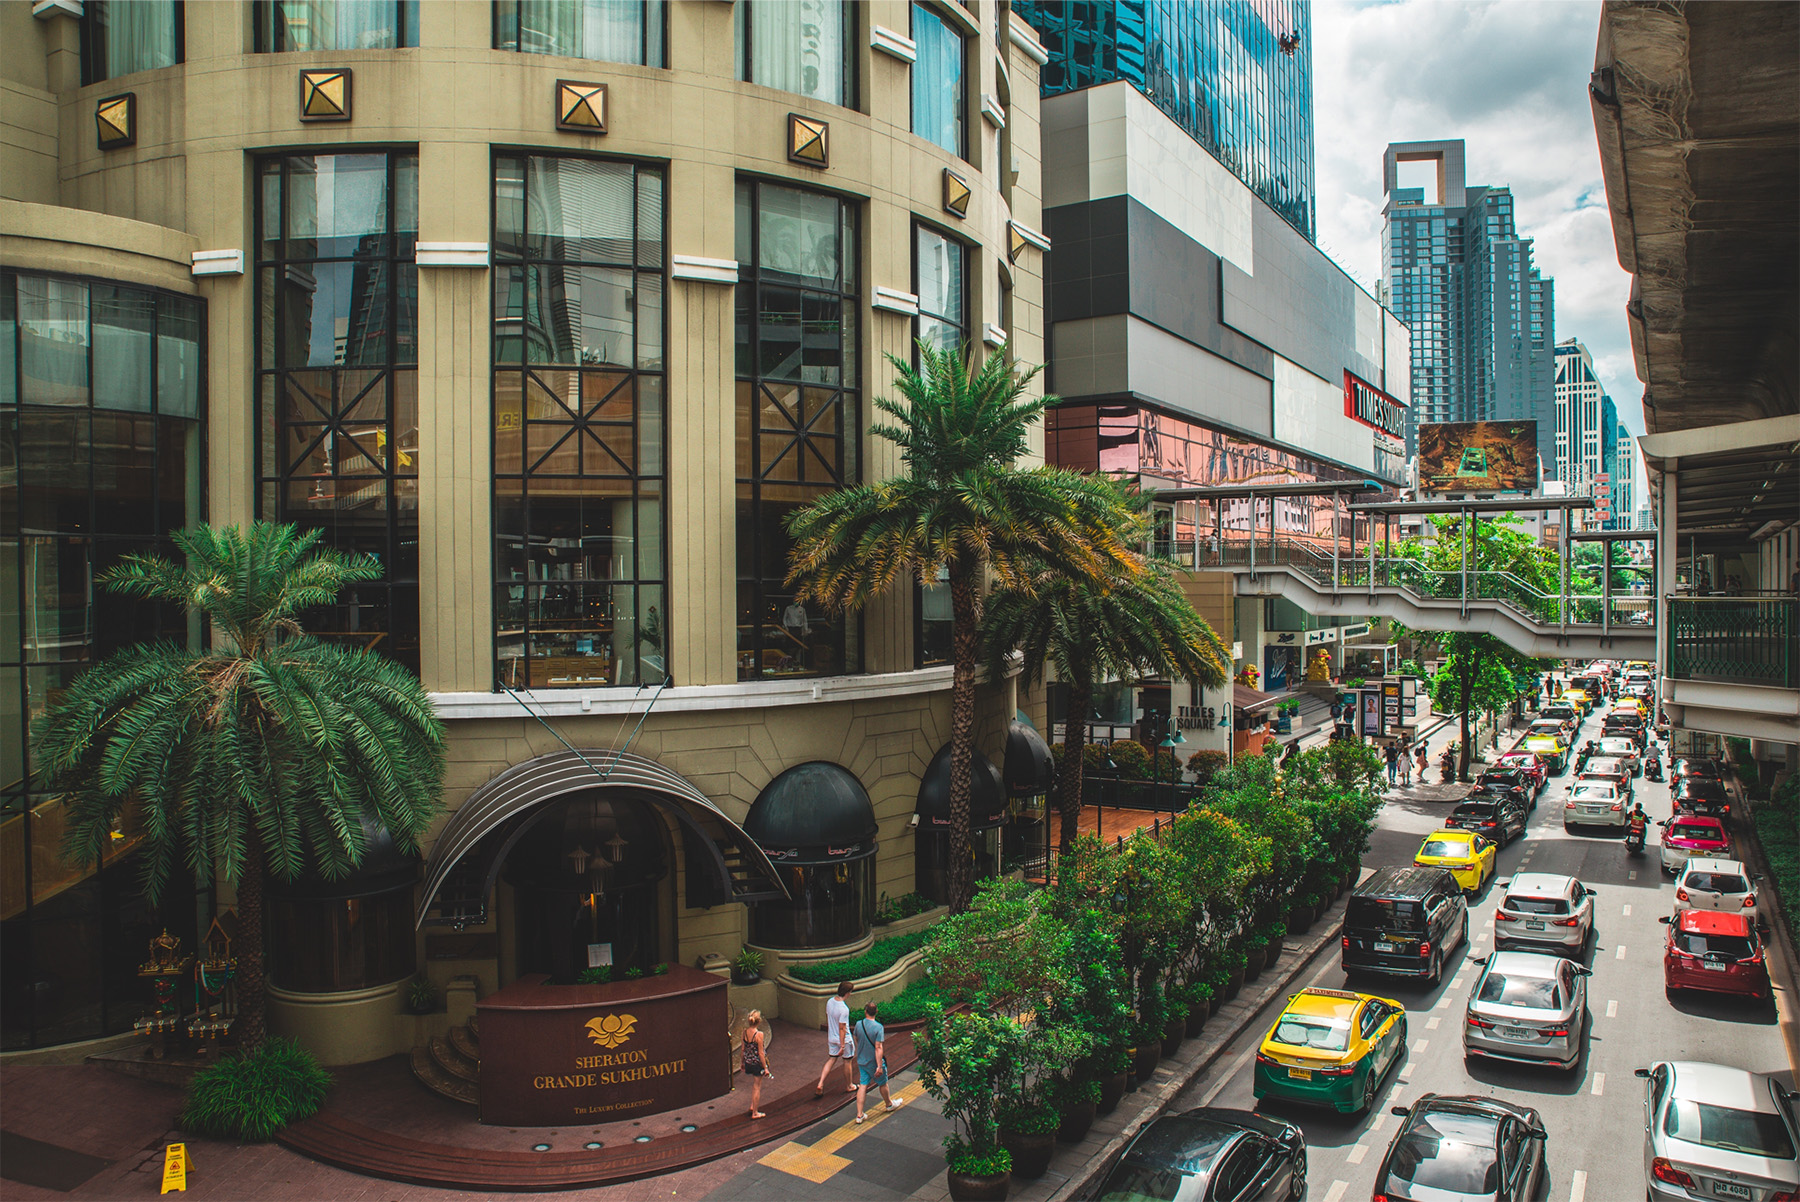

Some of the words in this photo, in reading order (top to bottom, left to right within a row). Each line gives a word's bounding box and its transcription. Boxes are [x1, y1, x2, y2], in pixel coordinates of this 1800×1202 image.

[1354, 383, 1384, 427] TIMES
[1384, 400, 1406, 439] SQUARE
[1178, 705, 1215, 718] TIMES
[1178, 718, 1215, 731] SQUARE
[575, 1049, 648, 1070] SHERATON
[533, 1073, 597, 1090] GRANDE
[601, 1059, 687, 1086] SUKHUMVIT
